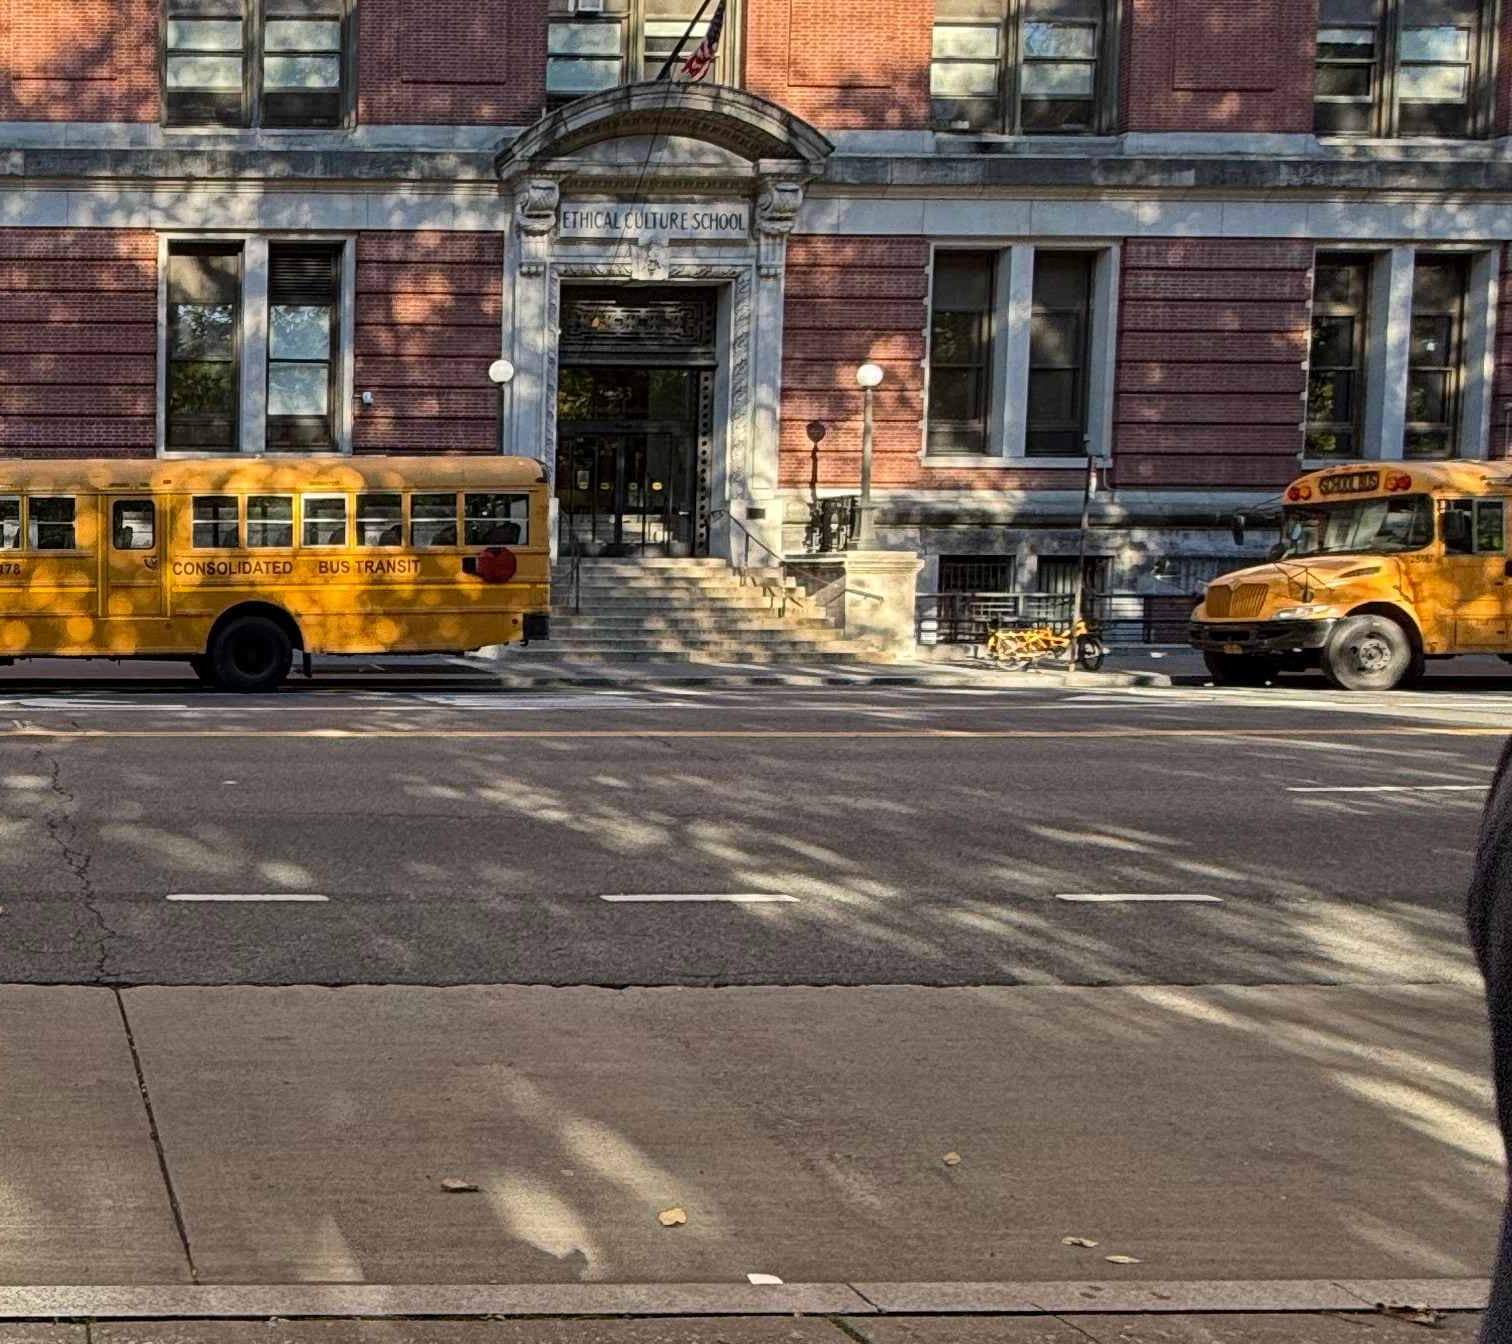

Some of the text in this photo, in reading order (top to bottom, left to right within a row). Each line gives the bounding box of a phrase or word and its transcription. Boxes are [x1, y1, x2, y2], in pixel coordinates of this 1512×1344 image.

[562, 210, 745, 231] ETHICAL CULTURE SCHOOL
[172, 559, 421, 576] CONSOLIDATED BUS TRANSIT
